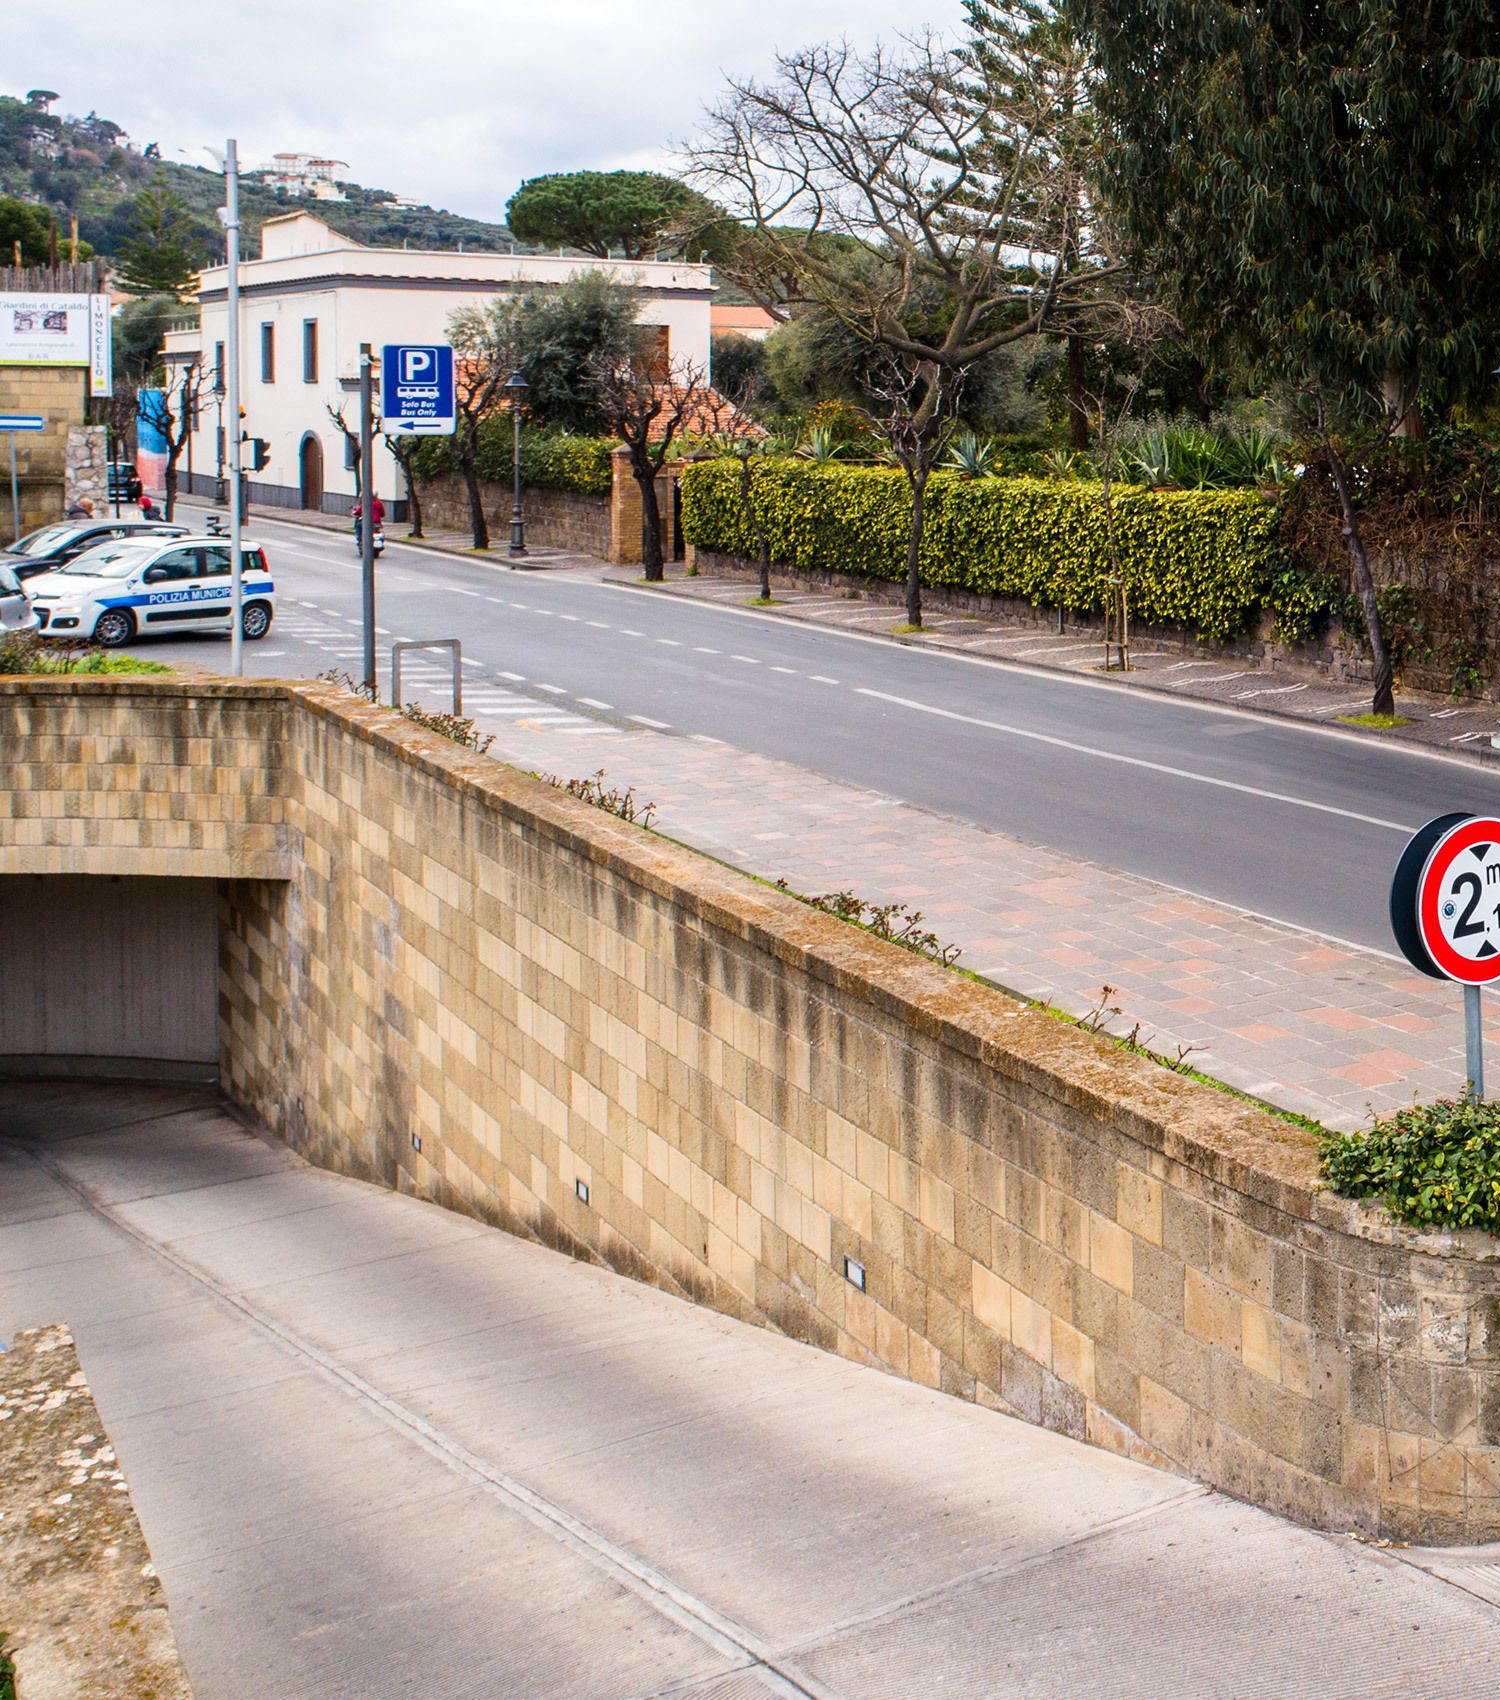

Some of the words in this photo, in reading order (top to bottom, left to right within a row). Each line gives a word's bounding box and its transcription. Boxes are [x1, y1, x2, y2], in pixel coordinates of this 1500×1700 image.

[95, 297, 104, 376] LIMONCELLO
[406, 351, 430, 381] P
[417, 409, 437, 417] Only
[149, 592, 190, 604] POLIZIA
[191, 586, 247, 600] MUNICIPE
